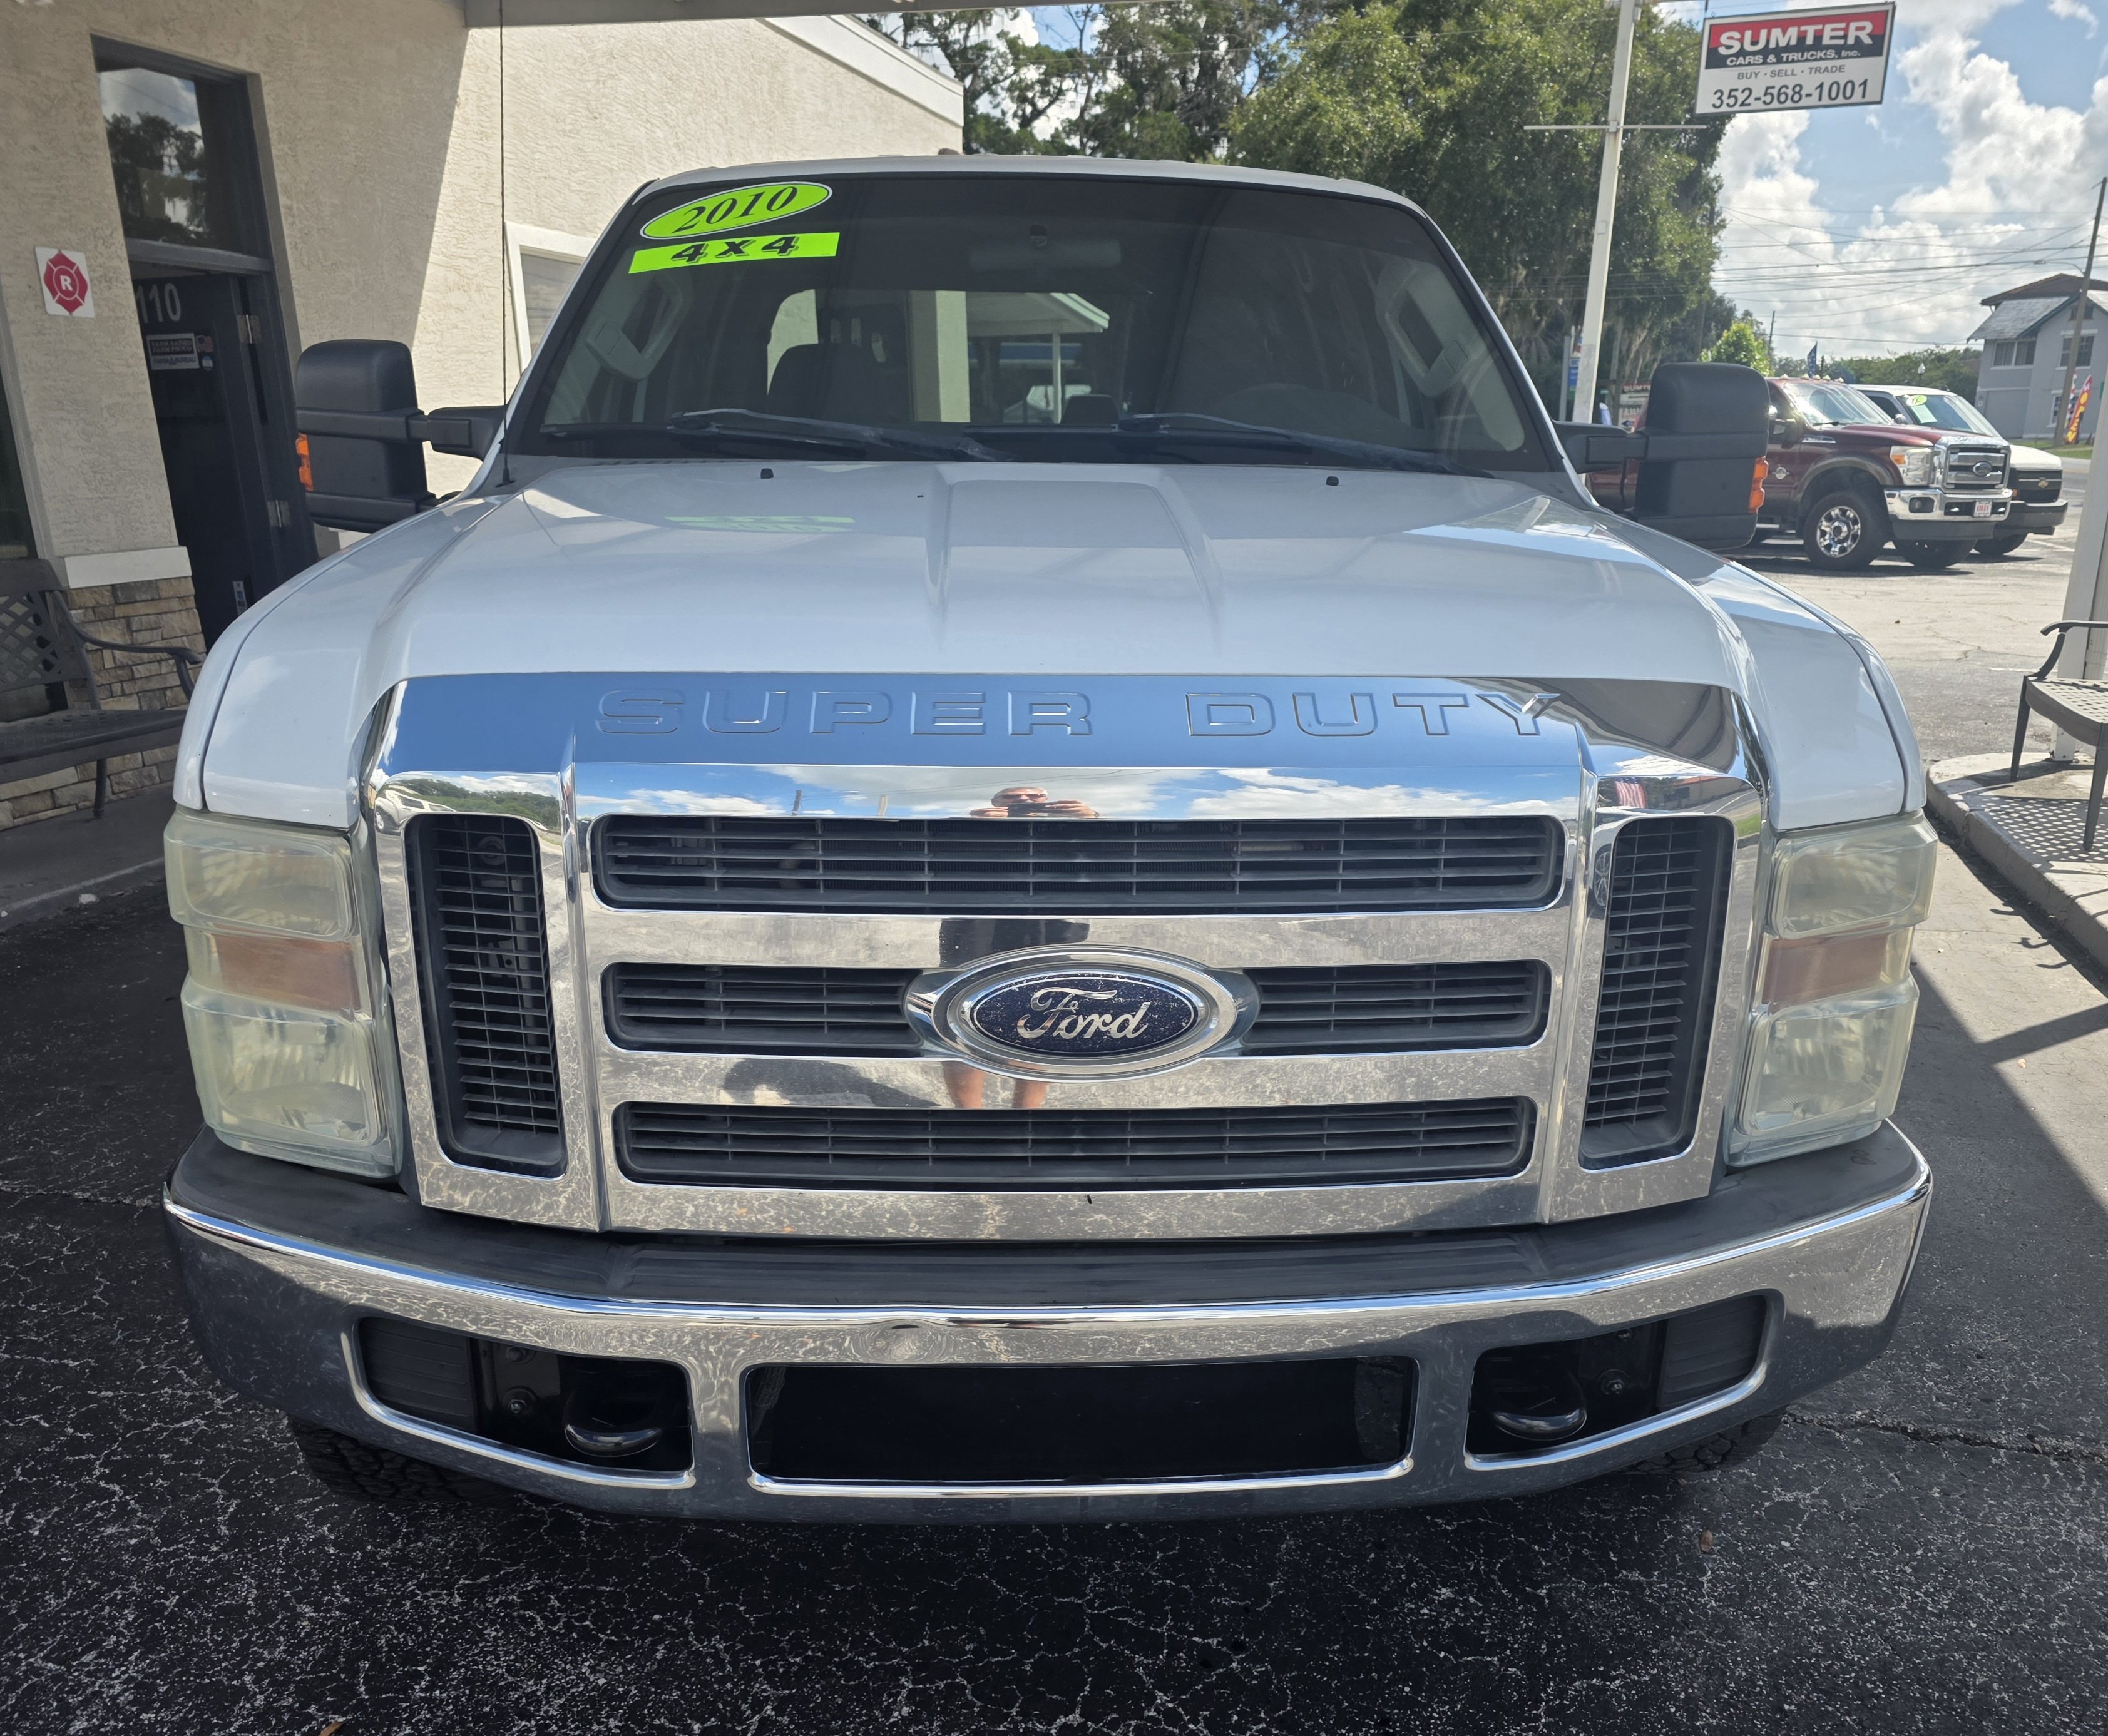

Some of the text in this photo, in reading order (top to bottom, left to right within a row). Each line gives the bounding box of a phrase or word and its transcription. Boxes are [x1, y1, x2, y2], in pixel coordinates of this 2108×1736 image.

[1718, 21, 1873, 55] SUMTER
[1727, 49, 1861, 66] CARS & TRUCKS, Inc.
[1737, 64, 1846, 80] BUY SELL TRADE
[1712, 78, 1868, 109] 352-568-1001
[672, 186, 798, 234] 2010
[59, 274, 73, 291] R
[595, 688, 1561, 737] SUPER DUTY
[1016, 986, 1151, 1039] Ford
